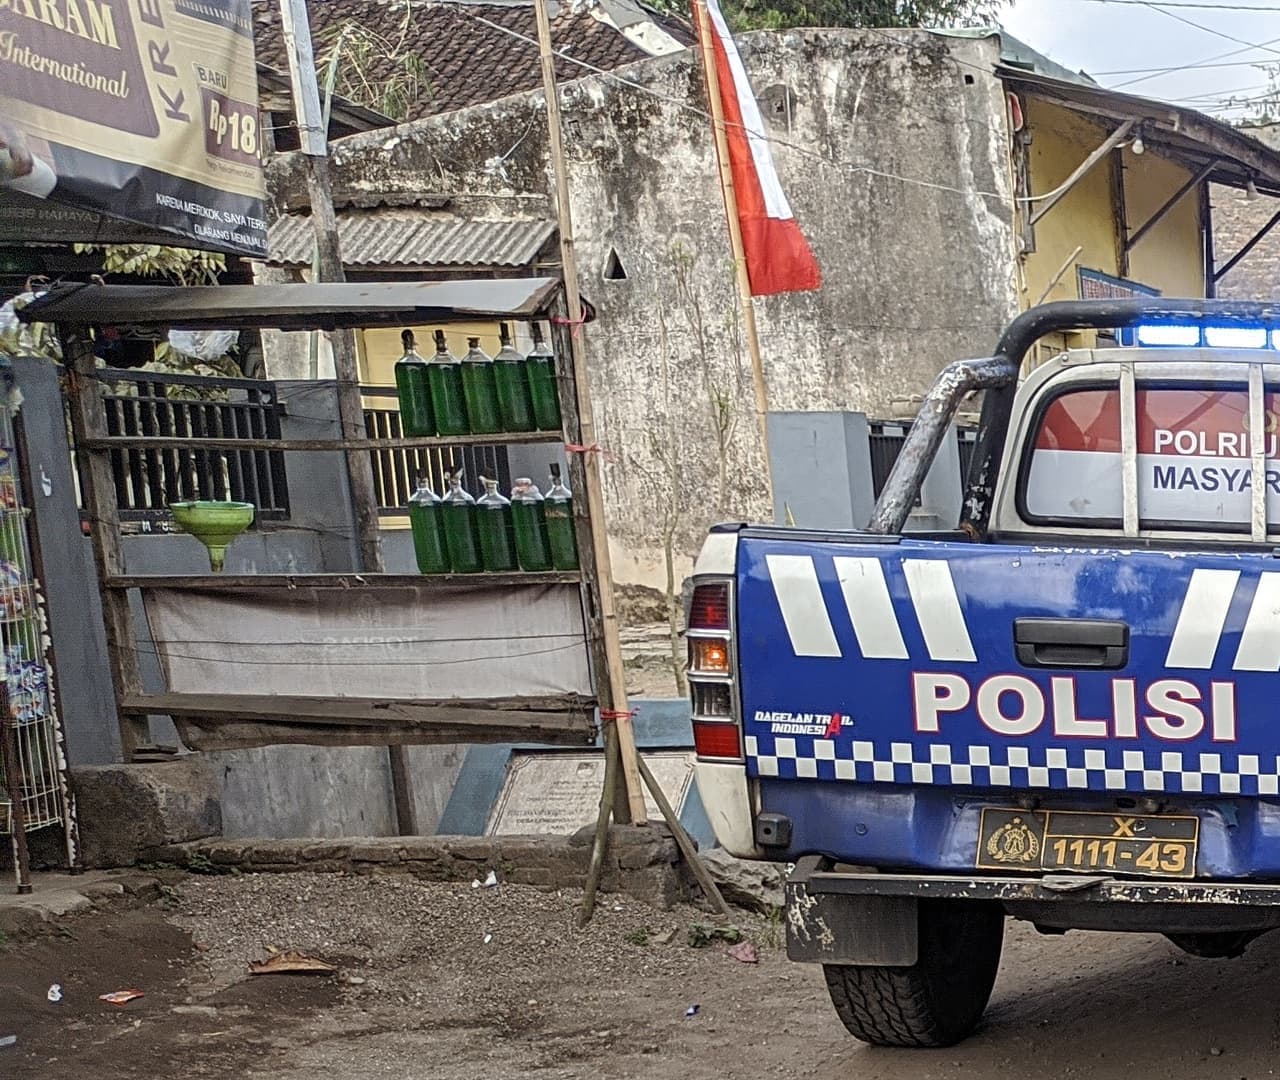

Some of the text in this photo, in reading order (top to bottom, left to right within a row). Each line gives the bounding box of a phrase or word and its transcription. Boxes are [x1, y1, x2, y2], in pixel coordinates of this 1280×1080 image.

[0, 0, 121, 50] ARAM
[0, 31, 130, 99] International
[199, 66, 228, 90] BARU
[223, 211, 247, 228] SAYA
[1153, 428, 1248, 457] POLRI
[912, 671, 1237, 742] POLISI
[1112, 816, 1136, 838] X
[1052, 838, 1188, 874] 1111-43
